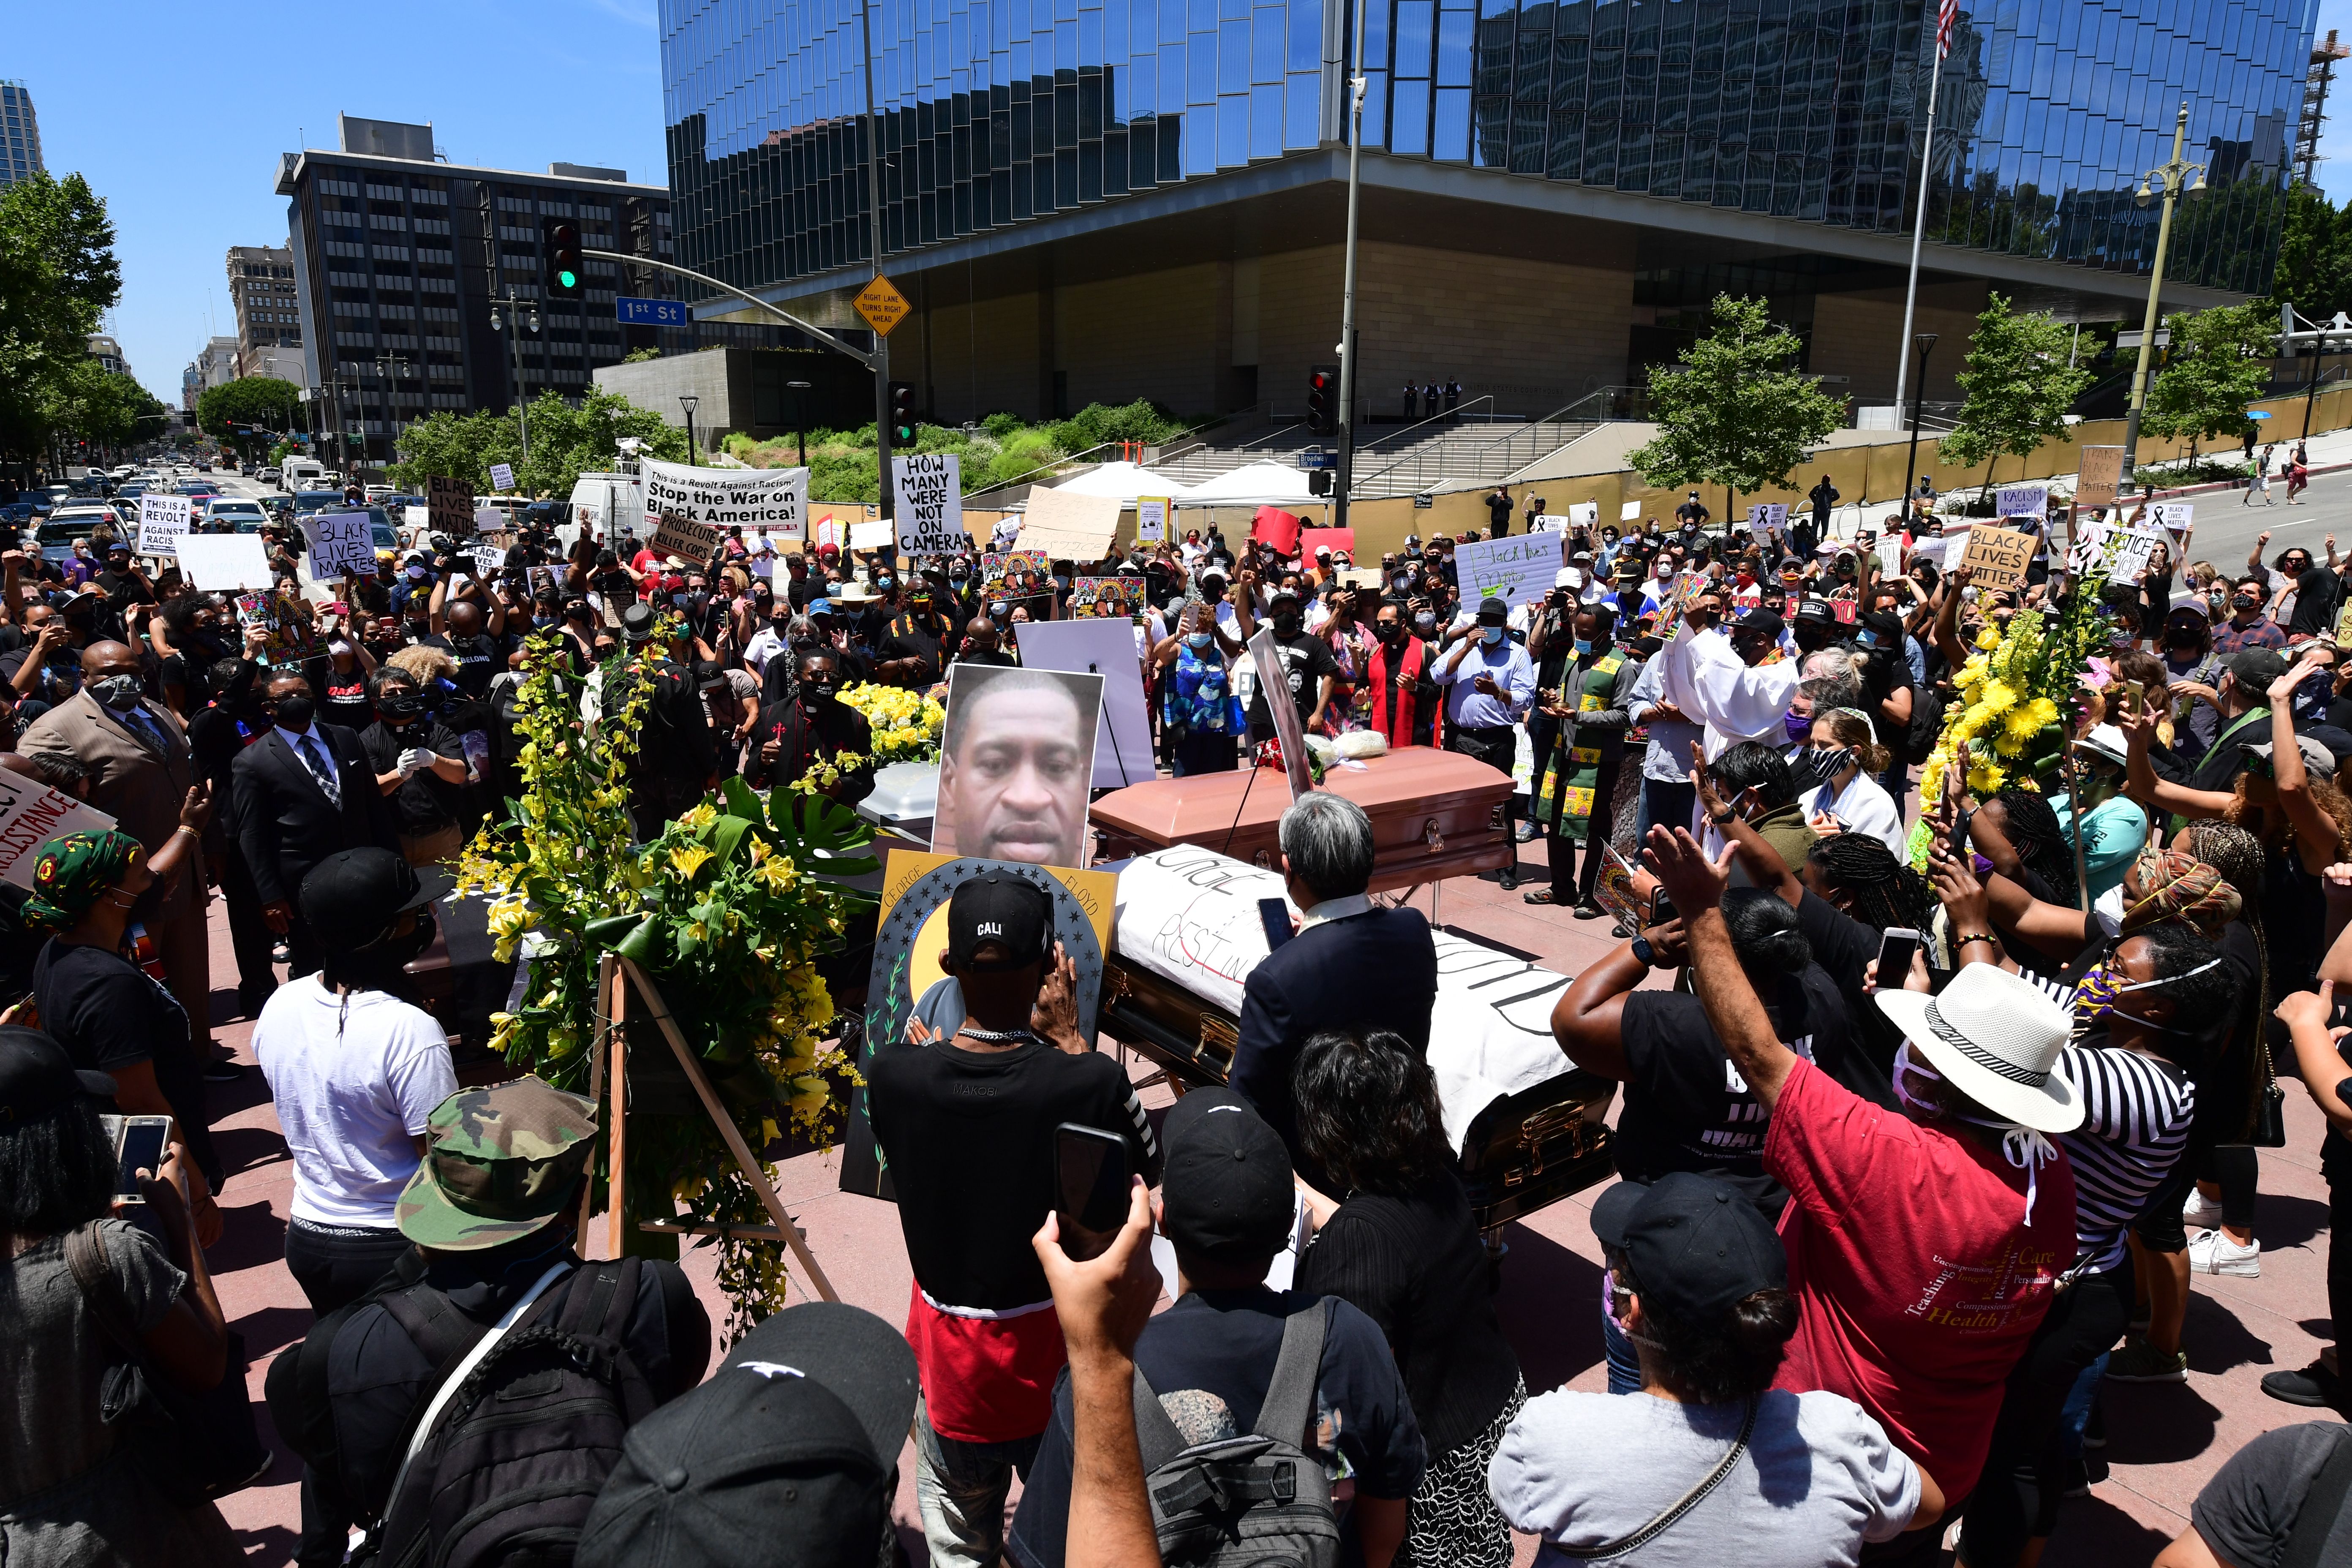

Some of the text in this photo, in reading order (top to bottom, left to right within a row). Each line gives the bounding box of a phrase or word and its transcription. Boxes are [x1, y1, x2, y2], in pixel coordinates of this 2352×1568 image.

[627, 302, 677, 320] 1st St
[862, 304, 882, 312] TURNS
[1300, 455, 1328, 463] Broadway
[2086, 449, 2120, 460] TRANS
[907, 457, 944, 475] HOW
[2083, 461, 2112, 474] BLACK
[431, 476, 474, 497] BLACK
[652, 471, 668, 482] This
[670, 476, 678, 484] is
[689, 479, 718, 489] Revolt
[720, 481, 756, 491] Against
[759, 479, 794, 488] Racism!
[901, 473, 949, 491] MANY
[2081, 482, 2112, 492] MATTER
[2082, 475, 2105, 483] LIVES
[429, 491, 474, 512] LIVES
[649, 482, 795, 505] Stop the War on
[907, 489, 947, 504] WERE
[2004, 490, 2042, 503] RACISM
[146, 500, 186, 511] THIS IS A
[647, 498, 795, 522] Black America!
[915, 504, 943, 520] NOT
[2000, 507, 2042, 516] PANDEMIC
[146, 510, 186, 523] REVOLT
[430, 511, 474, 536] MATTER
[144, 526, 184, 535] AGAINST
[317, 521, 368, 542] BLACK
[661, 514, 718, 544] PROSECUTE
[919, 520, 942, 534] ON
[2079, 528, 2102, 542] NO
[147, 535, 175, 546] RACIS
[656, 532, 684, 551] KILLER
[901, 533, 963, 551] CAMERA
[1020, 537, 1106, 553] JUSTICE
[1926, 539, 1947, 549] JUST
[1948, 534, 1969, 547] PALEST
[1970, 530, 2028, 555] BLACK
[313, 542, 368, 561] LIVES
[467, 547, 498, 558] BLACK
[686, 543, 709, 560] COPS
[1470, 544, 1519, 574] Black
[1945, 552, 1963, 563] BLAC
[1968, 546, 2022, 568] LIVES
[318, 557, 378, 576] MATTER
[460, 655, 490, 664] BELONG
[2089, 830, 2108, 847] FLY
[884, 864, 1100, 917] GEORGE FLOYD
[977, 921, 1002, 936] CALI
[1152, 914, 1248, 982] REST IN
[953, 1084, 997, 1096] MAKOBI
[1933, 1254, 1994, 1274] Uncompromising
[2019, 1246, 2055, 1265] Care
[1982, 1236, 2015, 1300] Excellence
[1995, 1252, 2018, 1299] Research
[1958, 1273, 1993, 1284] Integrity
[2014, 1274, 2052, 1284] Personaliz
[1904, 1269, 1955, 1317] Teaching
[1956, 1301, 2017, 1312] Compassionate
[1925, 1307, 1997, 1326] Health
